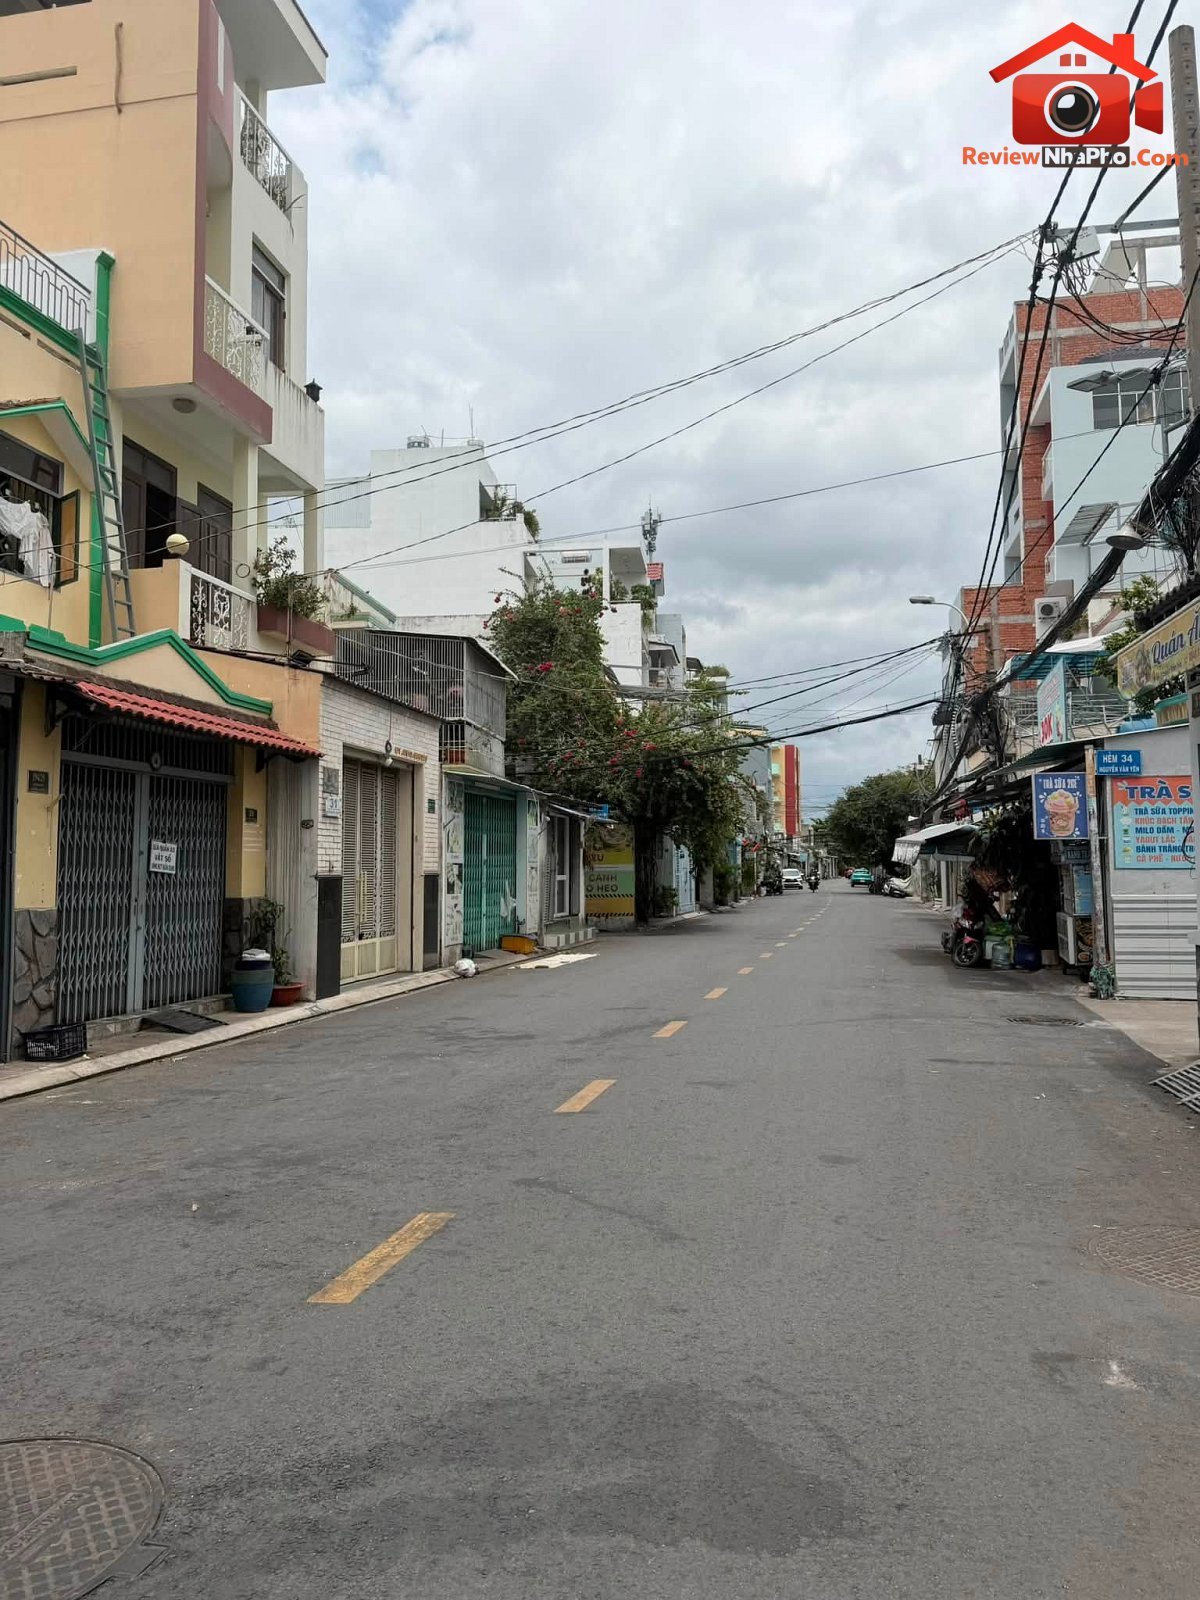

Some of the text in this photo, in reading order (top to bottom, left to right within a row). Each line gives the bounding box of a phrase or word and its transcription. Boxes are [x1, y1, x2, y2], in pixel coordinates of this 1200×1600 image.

[1151, 630, 1184, 664] Quán
[1121, 754, 1133, 763] 34
[1125, 779, 1173, 799] TRÀ
[1134, 806, 1149, 815] TRÀ
[1150, 806, 1166, 815] SỮA
[1136, 844, 1156, 853] BÁNH
[596, 884, 618, 893] HEO
